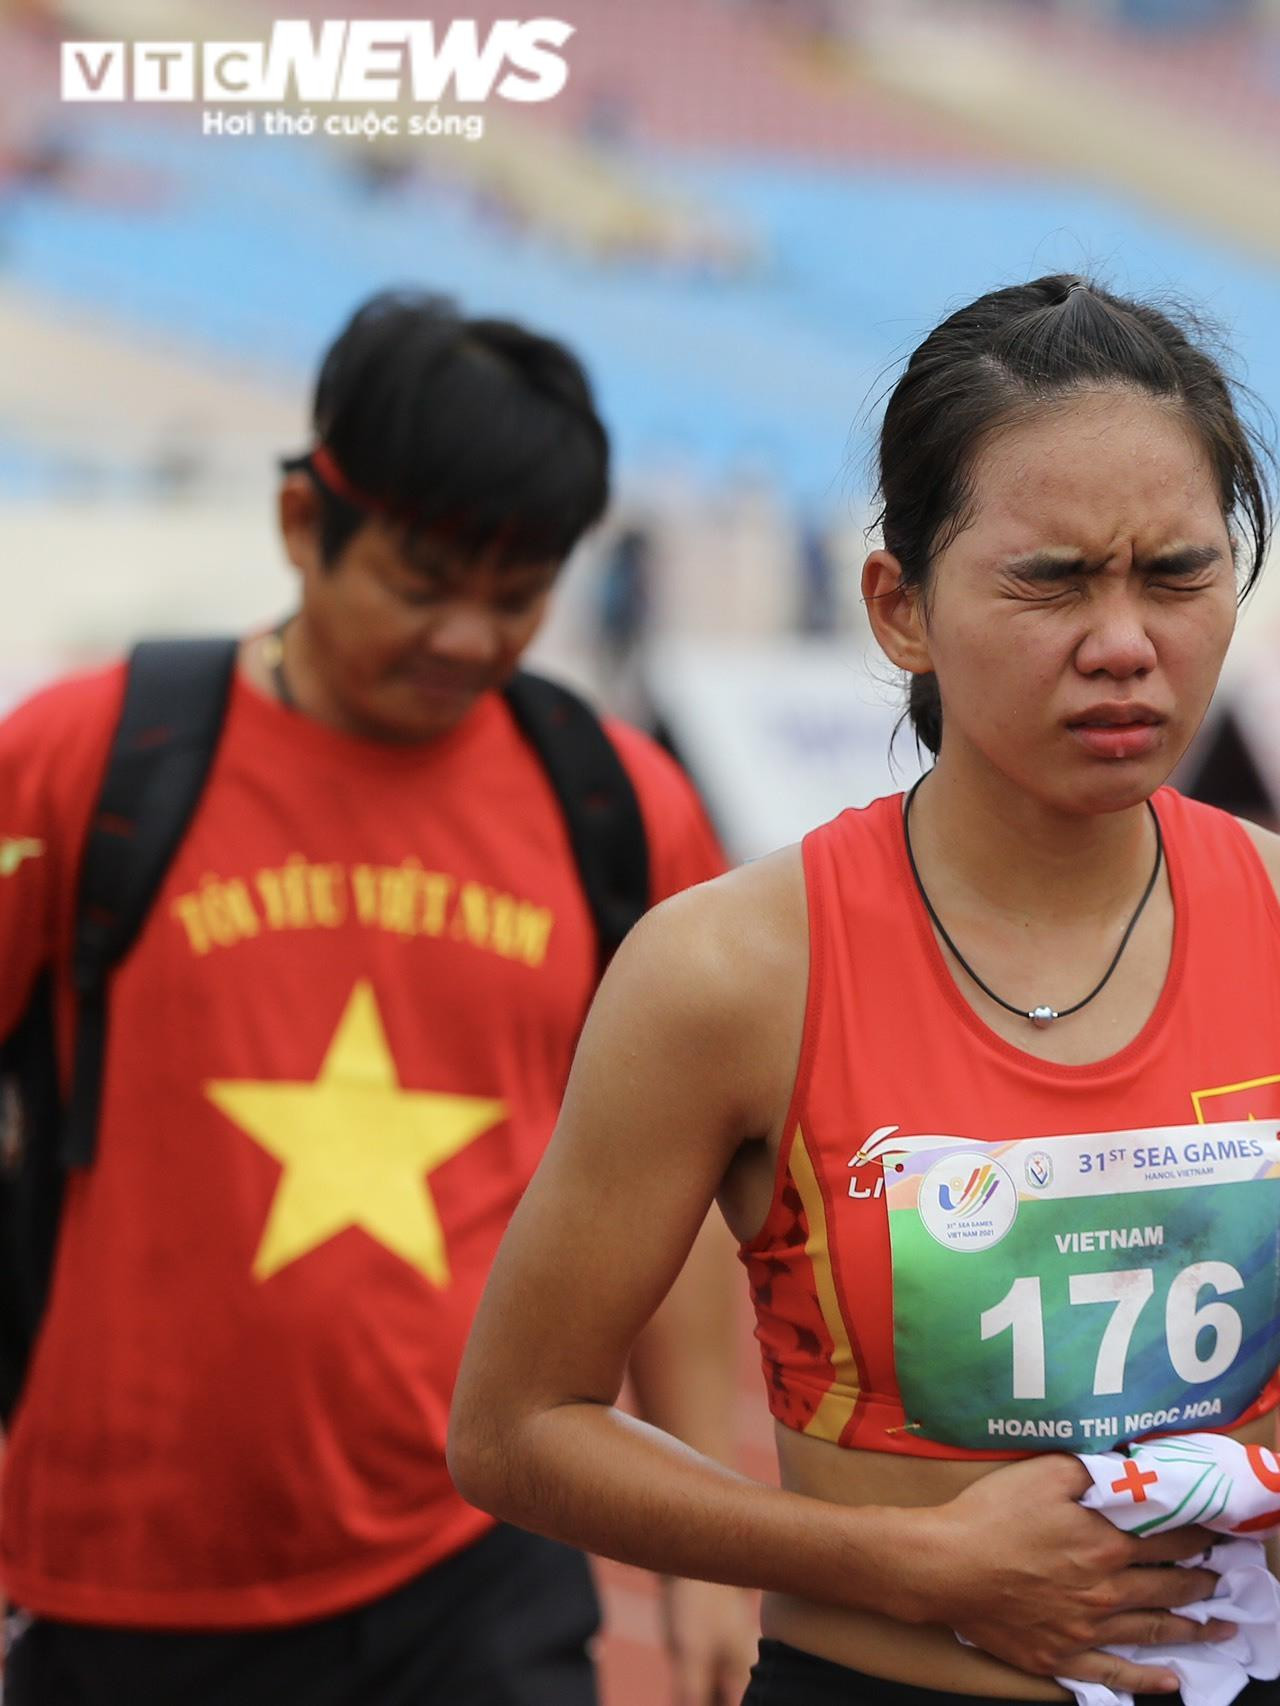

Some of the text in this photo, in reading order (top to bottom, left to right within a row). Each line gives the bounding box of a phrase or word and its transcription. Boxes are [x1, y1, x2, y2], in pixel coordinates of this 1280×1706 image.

[1133, 1146, 1178, 1169] SEA
[1183, 1139, 1264, 1163] GAMES
[1178, 1167, 1214, 1178] VIETNAM
[1055, 1225, 1164, 1254] VIETNAM
[980, 1261, 1245, 1400] 176
[988, 1398, 1222, 1438] HOANG THI NGOC HOA
